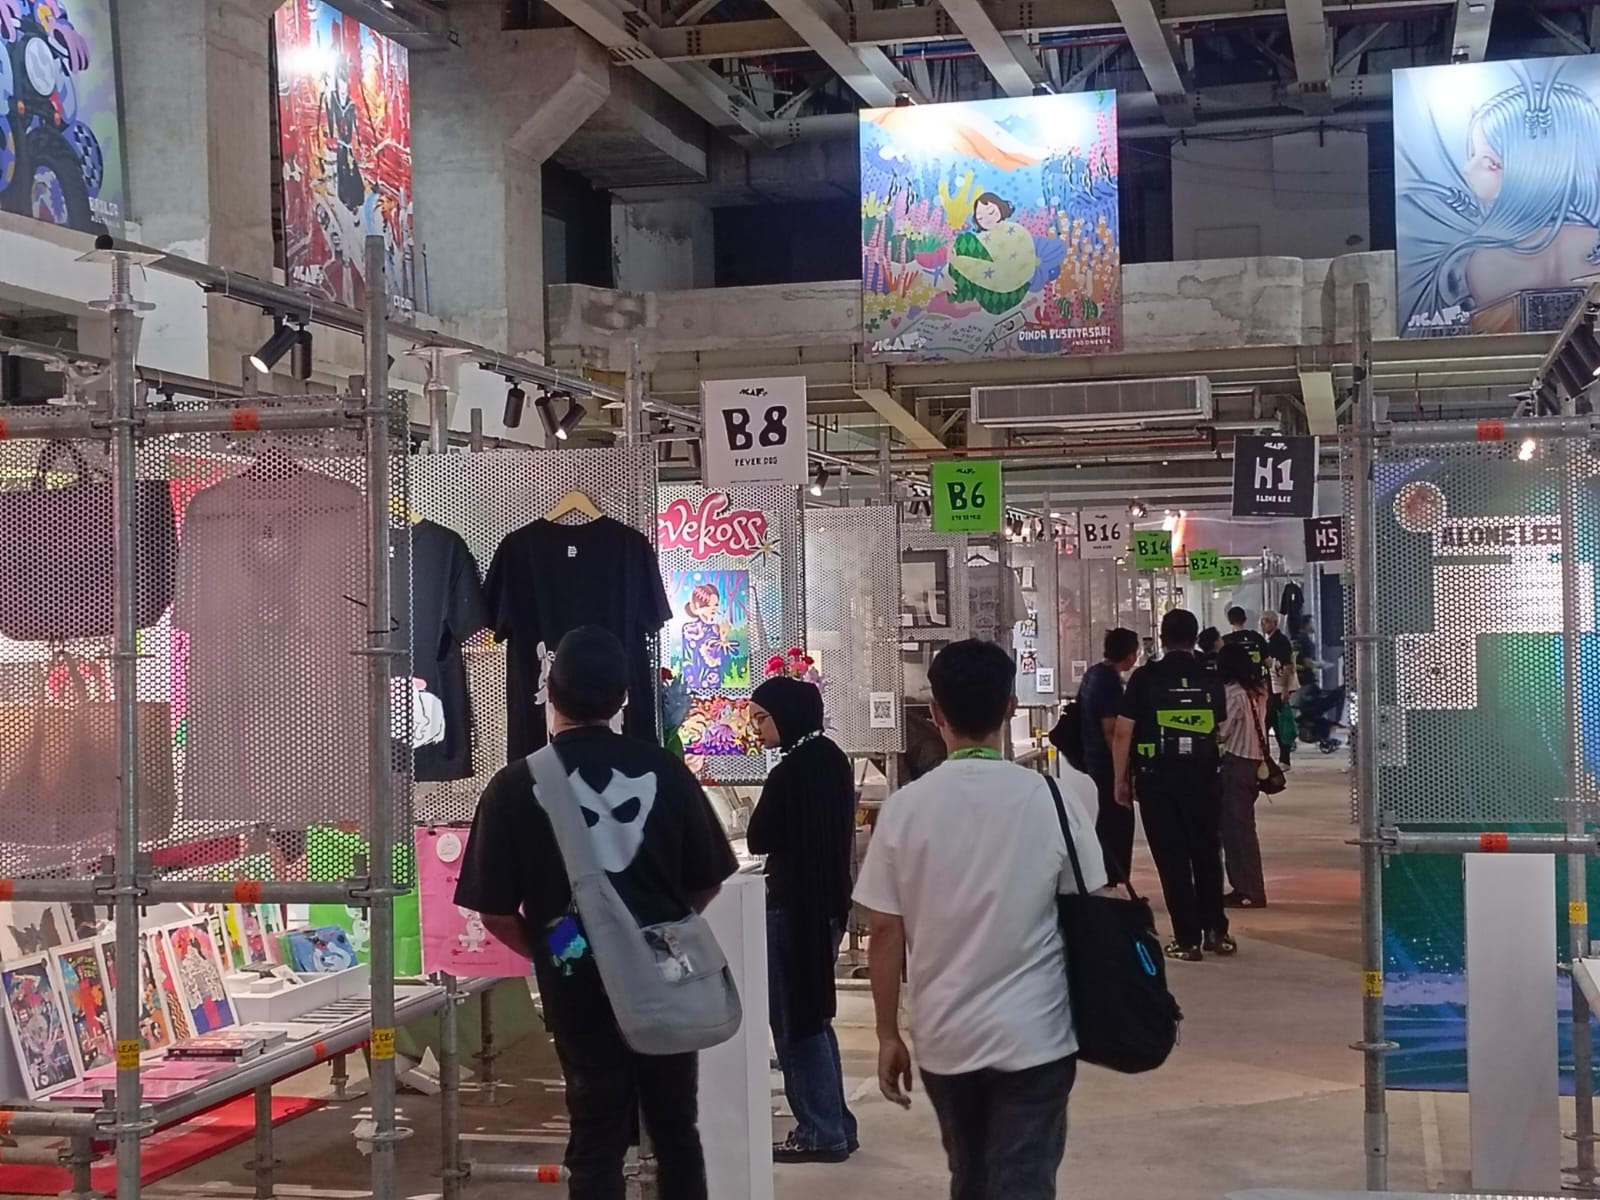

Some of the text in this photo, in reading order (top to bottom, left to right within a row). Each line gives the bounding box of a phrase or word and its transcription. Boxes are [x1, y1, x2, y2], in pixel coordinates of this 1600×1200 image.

[1018, 329, 1047, 341] DINDA
[722, 405, 787, 451] B8
[1254, 457, 1294, 491] H1
[947, 482, 986, 511] B6
[1084, 522, 1121, 542] B16
[1315, 528, 1338, 547] H5
[1137, 540, 1170, 555] B14
[1190, 557, 1218, 570] B24
